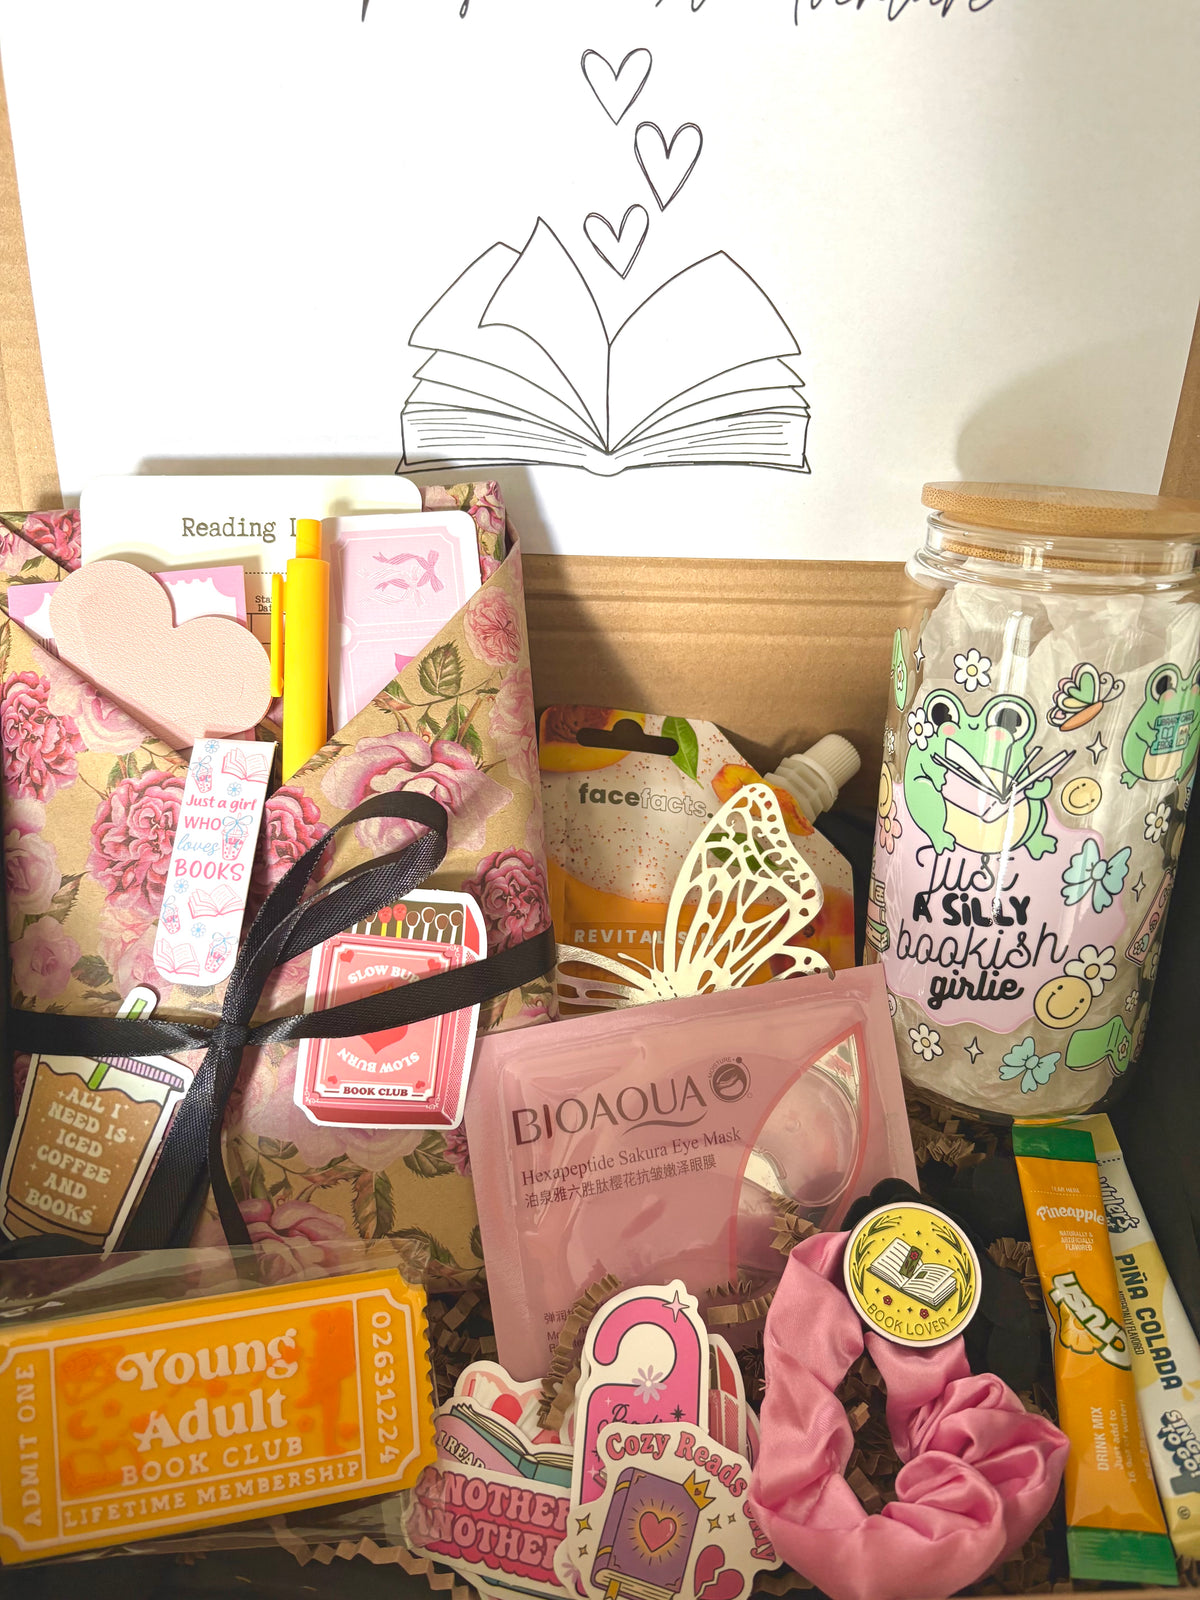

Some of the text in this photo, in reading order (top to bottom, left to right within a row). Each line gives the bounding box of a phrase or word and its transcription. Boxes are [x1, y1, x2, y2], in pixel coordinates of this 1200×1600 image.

[182, 517, 276, 543] Reading
[255, 595, 273, 604] Sta
[258, 604, 273, 612] Dat
[186, 794, 257, 812] Just a girl
[184, 815, 222, 831] WHO
[177, 833, 220, 856] loves
[174, 858, 245, 881] BOOKS
[915, 845, 1018, 903] Just
[913, 892, 933, 923] A
[897, 919, 1068, 969] bookish
[347, 965, 421, 984] SLOW BUR
[929, 971, 1024, 1010] girlie
[336, 1047, 421, 1074] SLOW BURN
[65, 1087, 122, 1120] ALL I
[343, 1086, 408, 1097] BOOK CLUB
[48, 1102, 128, 1144] NEED IS
[512, 1075, 707, 1146] BIOAQUA
[56, 1129, 103, 1158] ICED
[521, 1127, 741, 1186] Hexapeptide Sakura Eye Mask
[36, 1144, 111, 1185] COFFEE
[43, 1173, 88, 1199] AND
[24, 1188, 94, 1227] BOOKS
[1036, 1205, 1105, 1225] Pineapple
[867, 1303, 949, 1336] BOOK LOVER
[1115, 1253, 1149, 1300] PIÑA
[1135, 1307, 1183, 1390] COLADA
[116, 1328, 299, 1391] Young
[371, 1310, 401, 1464] 02631224
[132, 1388, 288, 1452] Adult
[1110, 1409, 1117, 1420] to
[16, 1363, 41, 1528] ADMIT ONE
[436, 1430, 446, 1446] I
[1090, 1407, 1110, 1471] DRINK MIX
[1110, 1423, 1120, 1444] add
[121, 1436, 304, 1487] BOOK CLUB
[605, 1432, 671, 1461] Cozy
[674, 1431, 748, 1498] Reads
[63, 1460, 360, 1529] LIFETIME MEMBERSHIP
